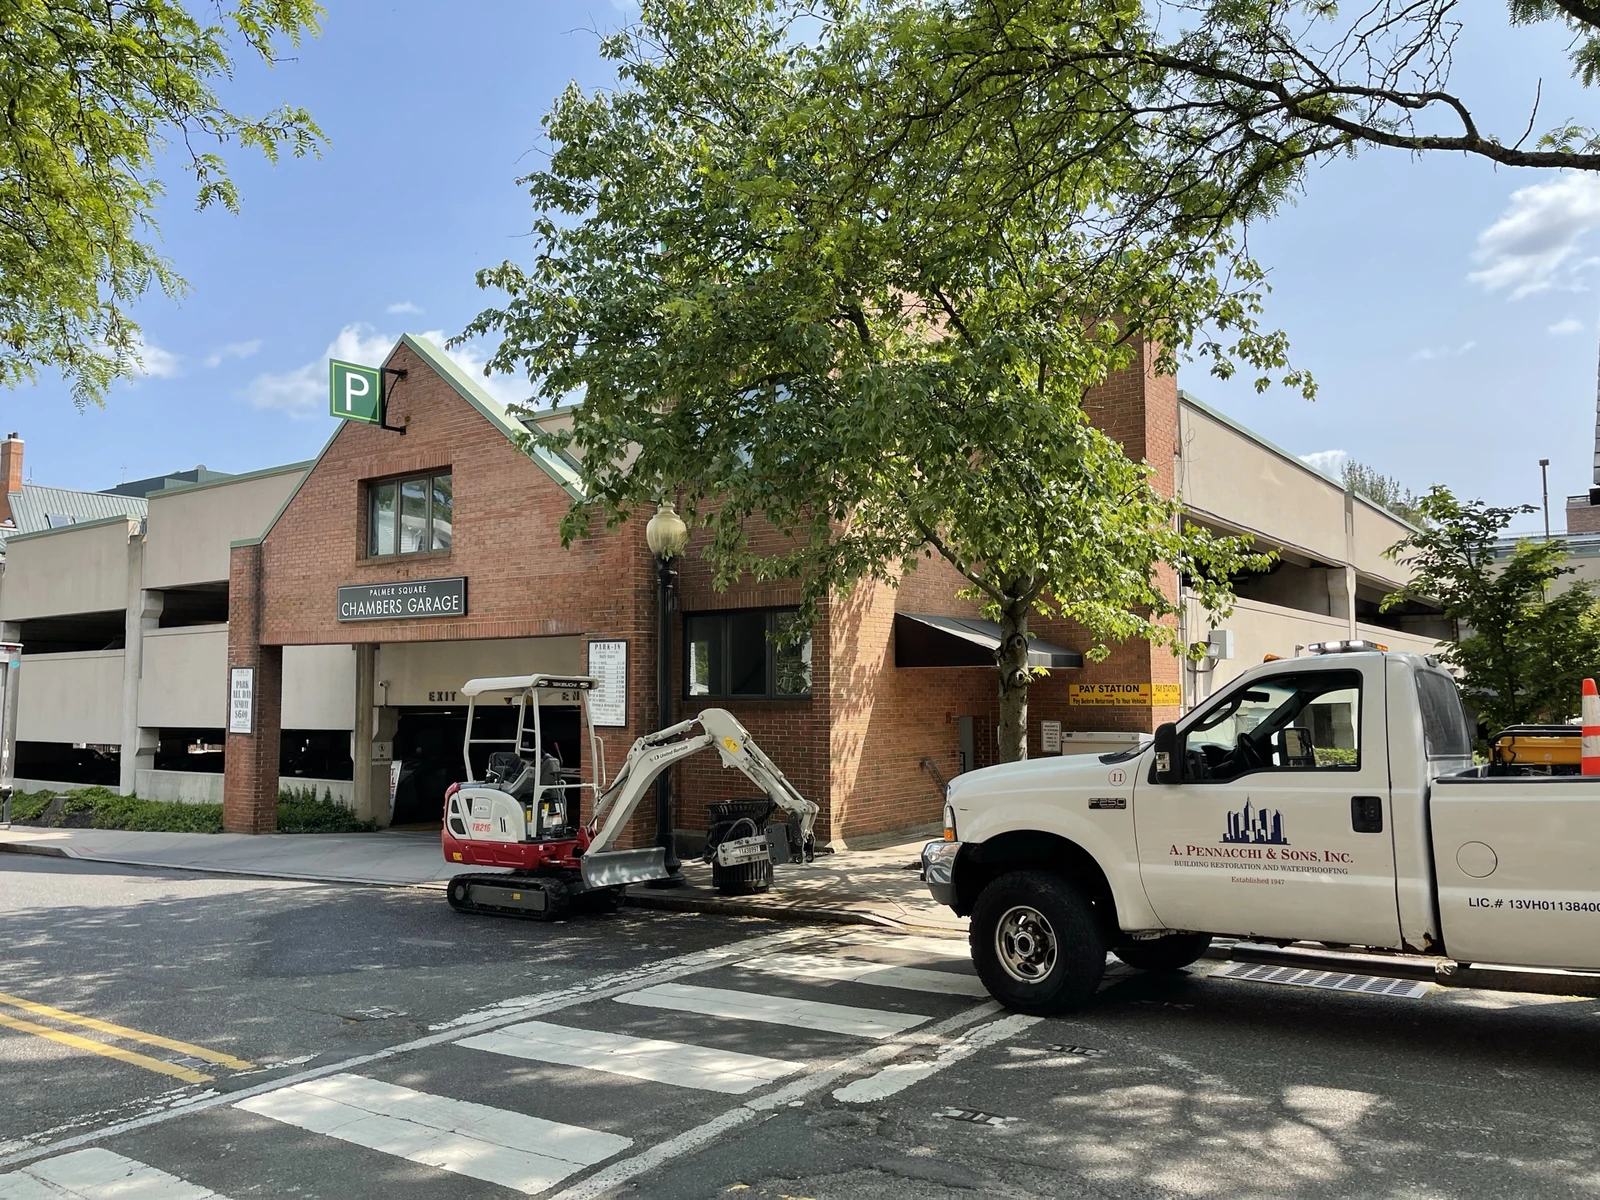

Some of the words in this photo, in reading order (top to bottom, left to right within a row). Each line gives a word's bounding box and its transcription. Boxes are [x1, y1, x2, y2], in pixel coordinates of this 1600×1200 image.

[346, 372, 369, 411] P
[369, 588, 395, 596] PALMER
[398, 585, 427, 595] SQUARE
[341, 599, 402, 616] CHAMBERS
[407, 595, 459, 612] GARAGE
[236, 680, 249, 689] PARK
[1079, 685, 1096, 693] PAY
[1098, 685, 1139, 693] STATION
[1155, 685, 1163, 693] PAY
[428, 691, 457, 702] EXIT
[660, 750, 673, 758] United
[673, 745, 688, 753] Rentals
[1113, 773, 1122, 782] 11
[472, 823, 491, 832] TB216
[1169, 845, 1183, 856] A.
[1186, 845, 1262, 859] PENNACCHI
[1266, 848, 1277, 859] &
[1281, 849, 1321, 863] SONS,
[1324, 851, 1354, 864] INC.
[1174, 860, 1209, 868] BUILDING
[1210, 862, 1261, 870] RESTORATION
[1280, 865, 1348, 875] WATERPROOFING
[1231, 876, 1270, 885] Established
[1468, 897, 1503, 908] LIC.#
